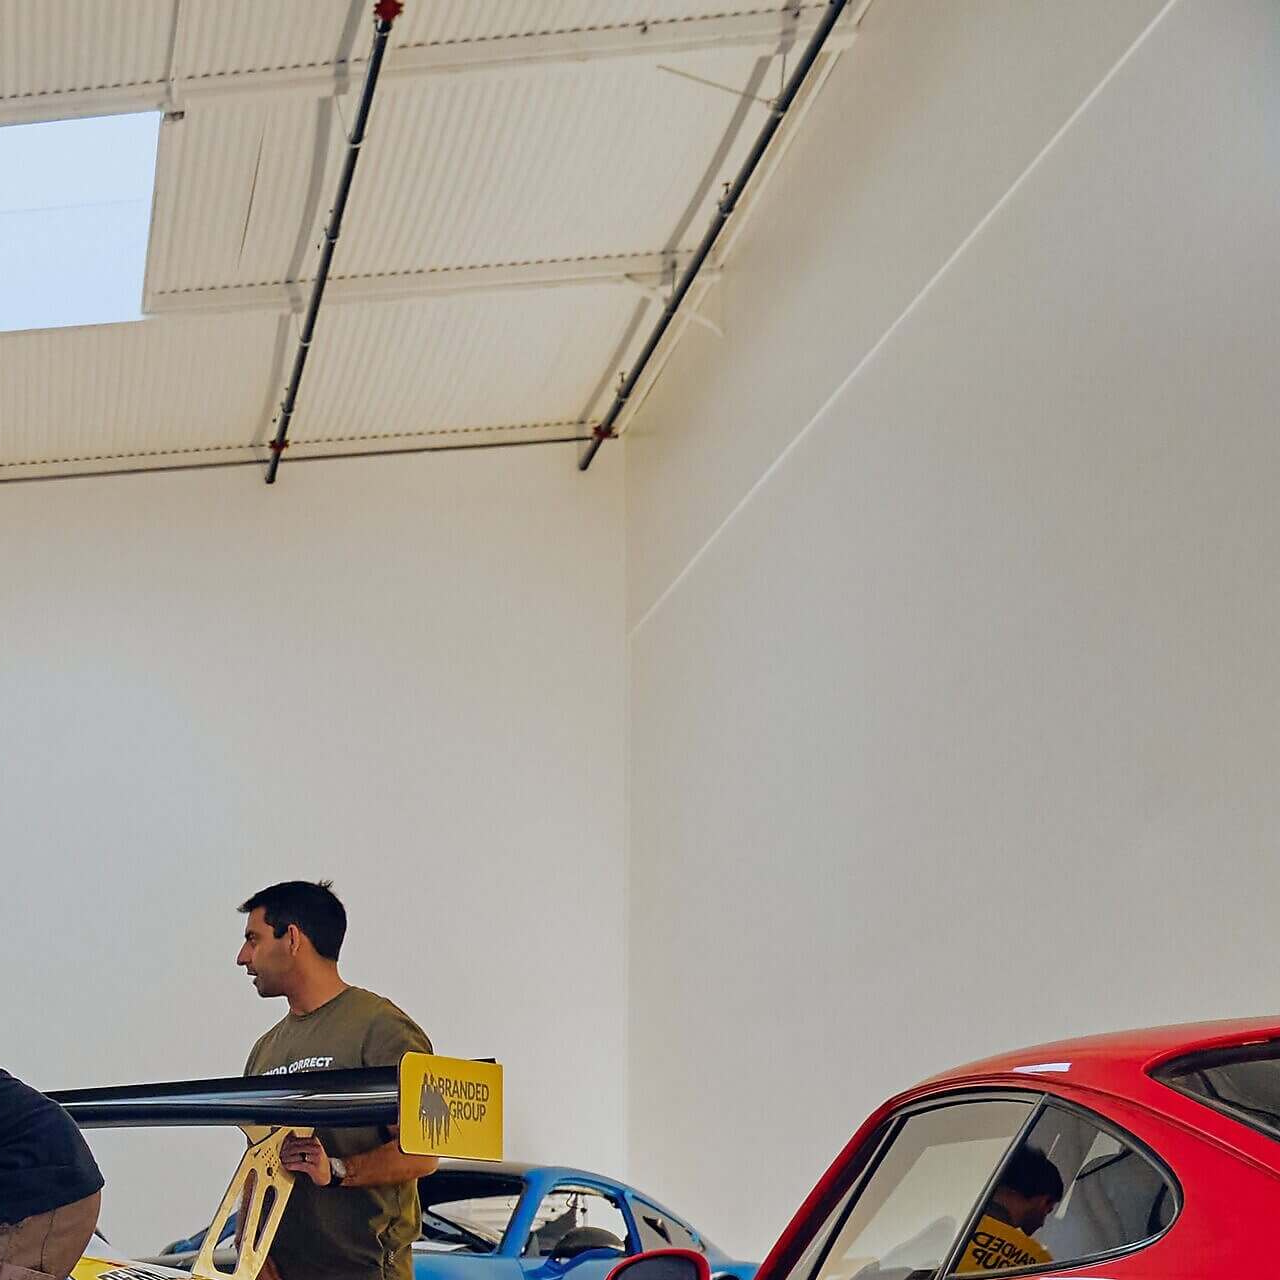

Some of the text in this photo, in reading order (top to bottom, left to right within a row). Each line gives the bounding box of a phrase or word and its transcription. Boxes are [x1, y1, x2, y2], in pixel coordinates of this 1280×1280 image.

[288, 1056, 334, 1073] CORRECT
[437, 1077, 490, 1102] BRANDED
[448, 1100, 487, 1123] GROUP
